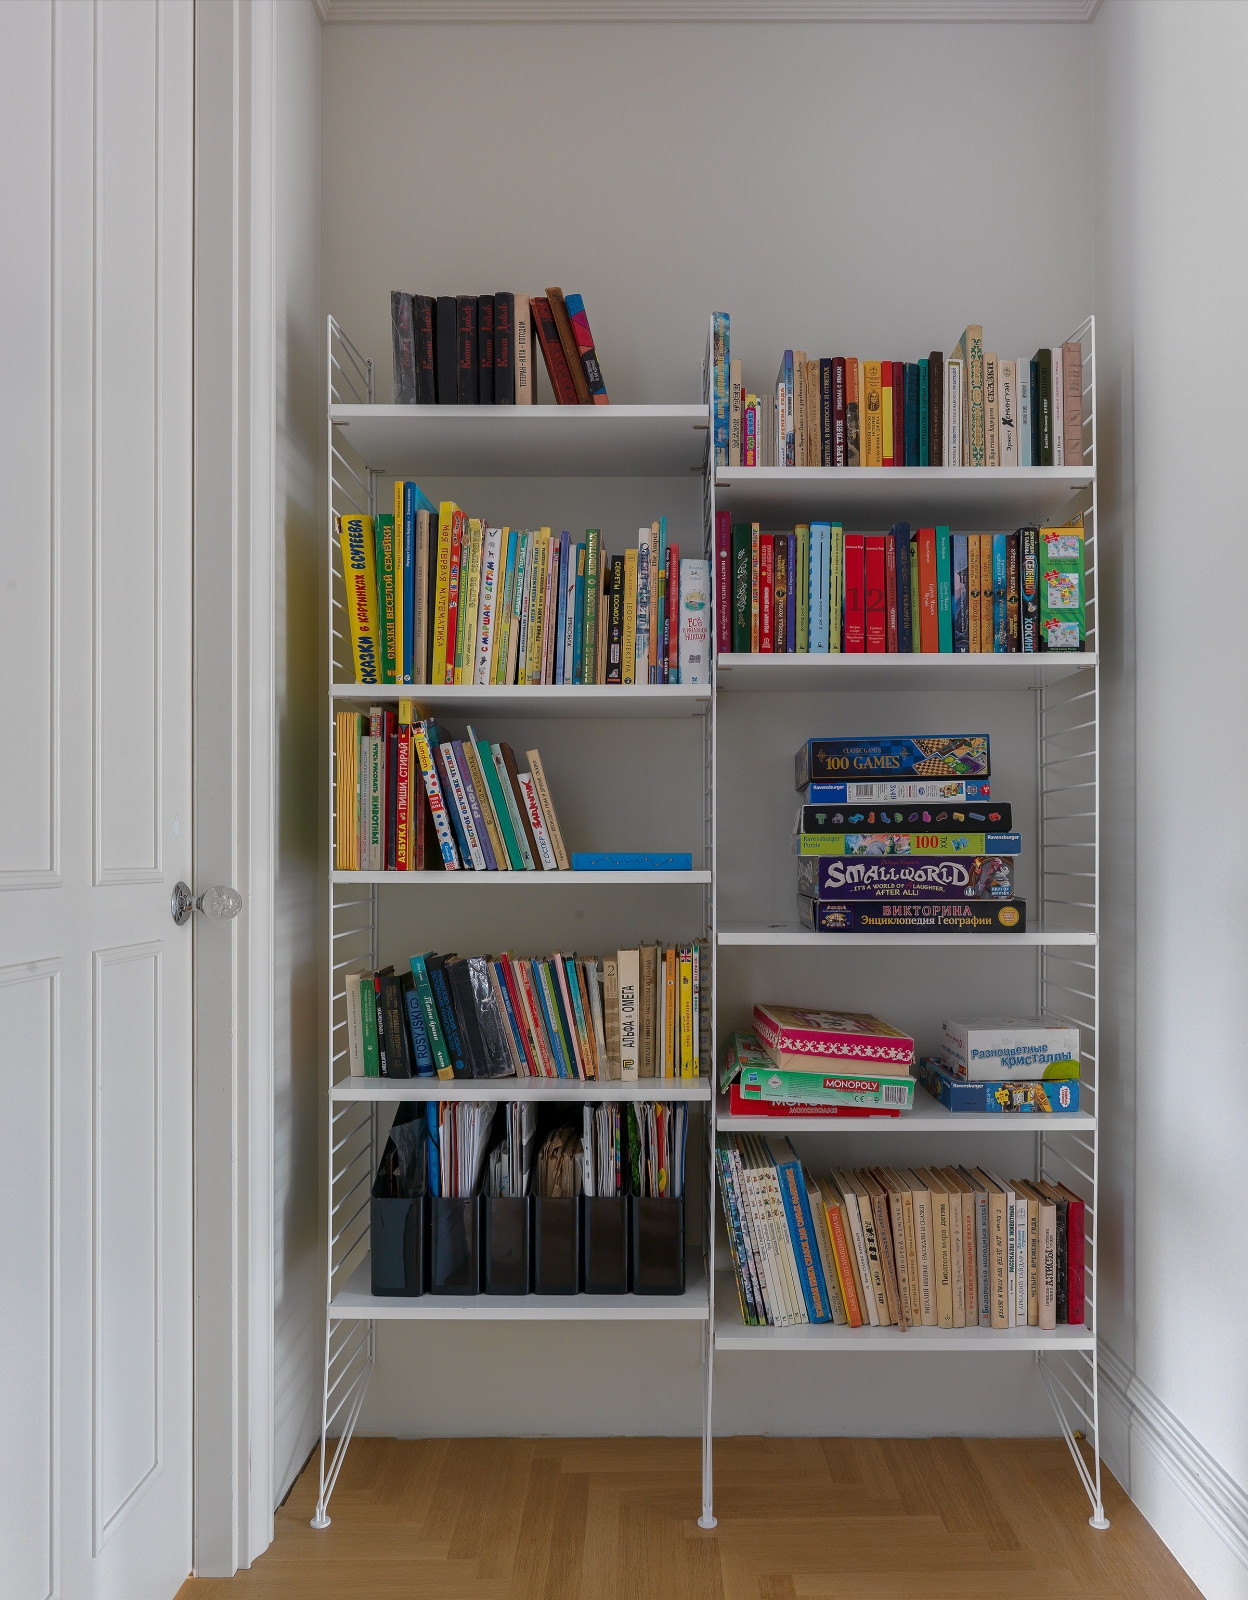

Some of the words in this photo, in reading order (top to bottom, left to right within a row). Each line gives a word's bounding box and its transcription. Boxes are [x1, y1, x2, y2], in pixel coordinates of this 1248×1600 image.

[382, 526, 393, 571] СЕМЕЙКИ
[485, 562, 495, 592] ДЕТЯМ
[588, 578, 596, 586] О
[1025, 555, 1036, 594] ВСЕЛЕННОЙ
[356, 575, 369, 623] КАРТИНКАХ
[384, 574, 395, 618] ВЕСЕЛОЙ
[848, 588, 862, 611] 1
[867, 589, 885, 612] 2
[482, 604, 491, 644] МАРШАК
[1025, 618, 1033, 654] ХОКИНГ
[386, 622, 397, 660] СКАЗКИ
[357, 636, 378, 685] СКАЗКИ
[399, 742, 408, 777] СТИРАЙ
[418, 741, 429, 768] London
[444, 748, 456, 778] ЧТЕНИЮ
[826, 757, 849, 769] 100
[854, 756, 900, 769] GAMES
[399, 780, 407, 810] ПИШИ,
[453, 779, 467, 814] ОБУЧЕНИЕ
[466, 784, 481, 818] РАФА
[520, 778, 542, 829] ЗАДАЧНИК
[398, 822, 406, 863] АЗБУКА
[464, 816, 477, 848] БЫСТРОЕ
[915, 836, 938, 848] 100
[876, 888, 901, 896] AFTER
[902, 888, 919, 896] ALL!
[896, 882, 904, 890] OF
[862, 916, 935, 926] Энциклопедия
[938, 916, 992, 928] Географии
[883, 906, 972, 916] ВИКТОРИНА
[622, 986, 634, 1012] ОМЕГА
[412, 1010, 428, 1058] ROSYJSKI
[623, 1021, 634, 1047] АЛЬФА
[972, 1045, 1048, 1060] Разноцветные
[1001, 1052, 1072, 1068] кристаллы
[825, 1080, 878, 1090] MONOPOLY
[795, 1205, 806, 1227] САМЫХ
[803, 1240, 814, 1266] СКАЗОК
[942, 1250, 950, 1286] Писатели
[1045, 1250, 1053, 1286] АЛИСЫ
[849, 1298, 858, 1312] КАК
[981, 1270, 989, 1314] Беларускія
